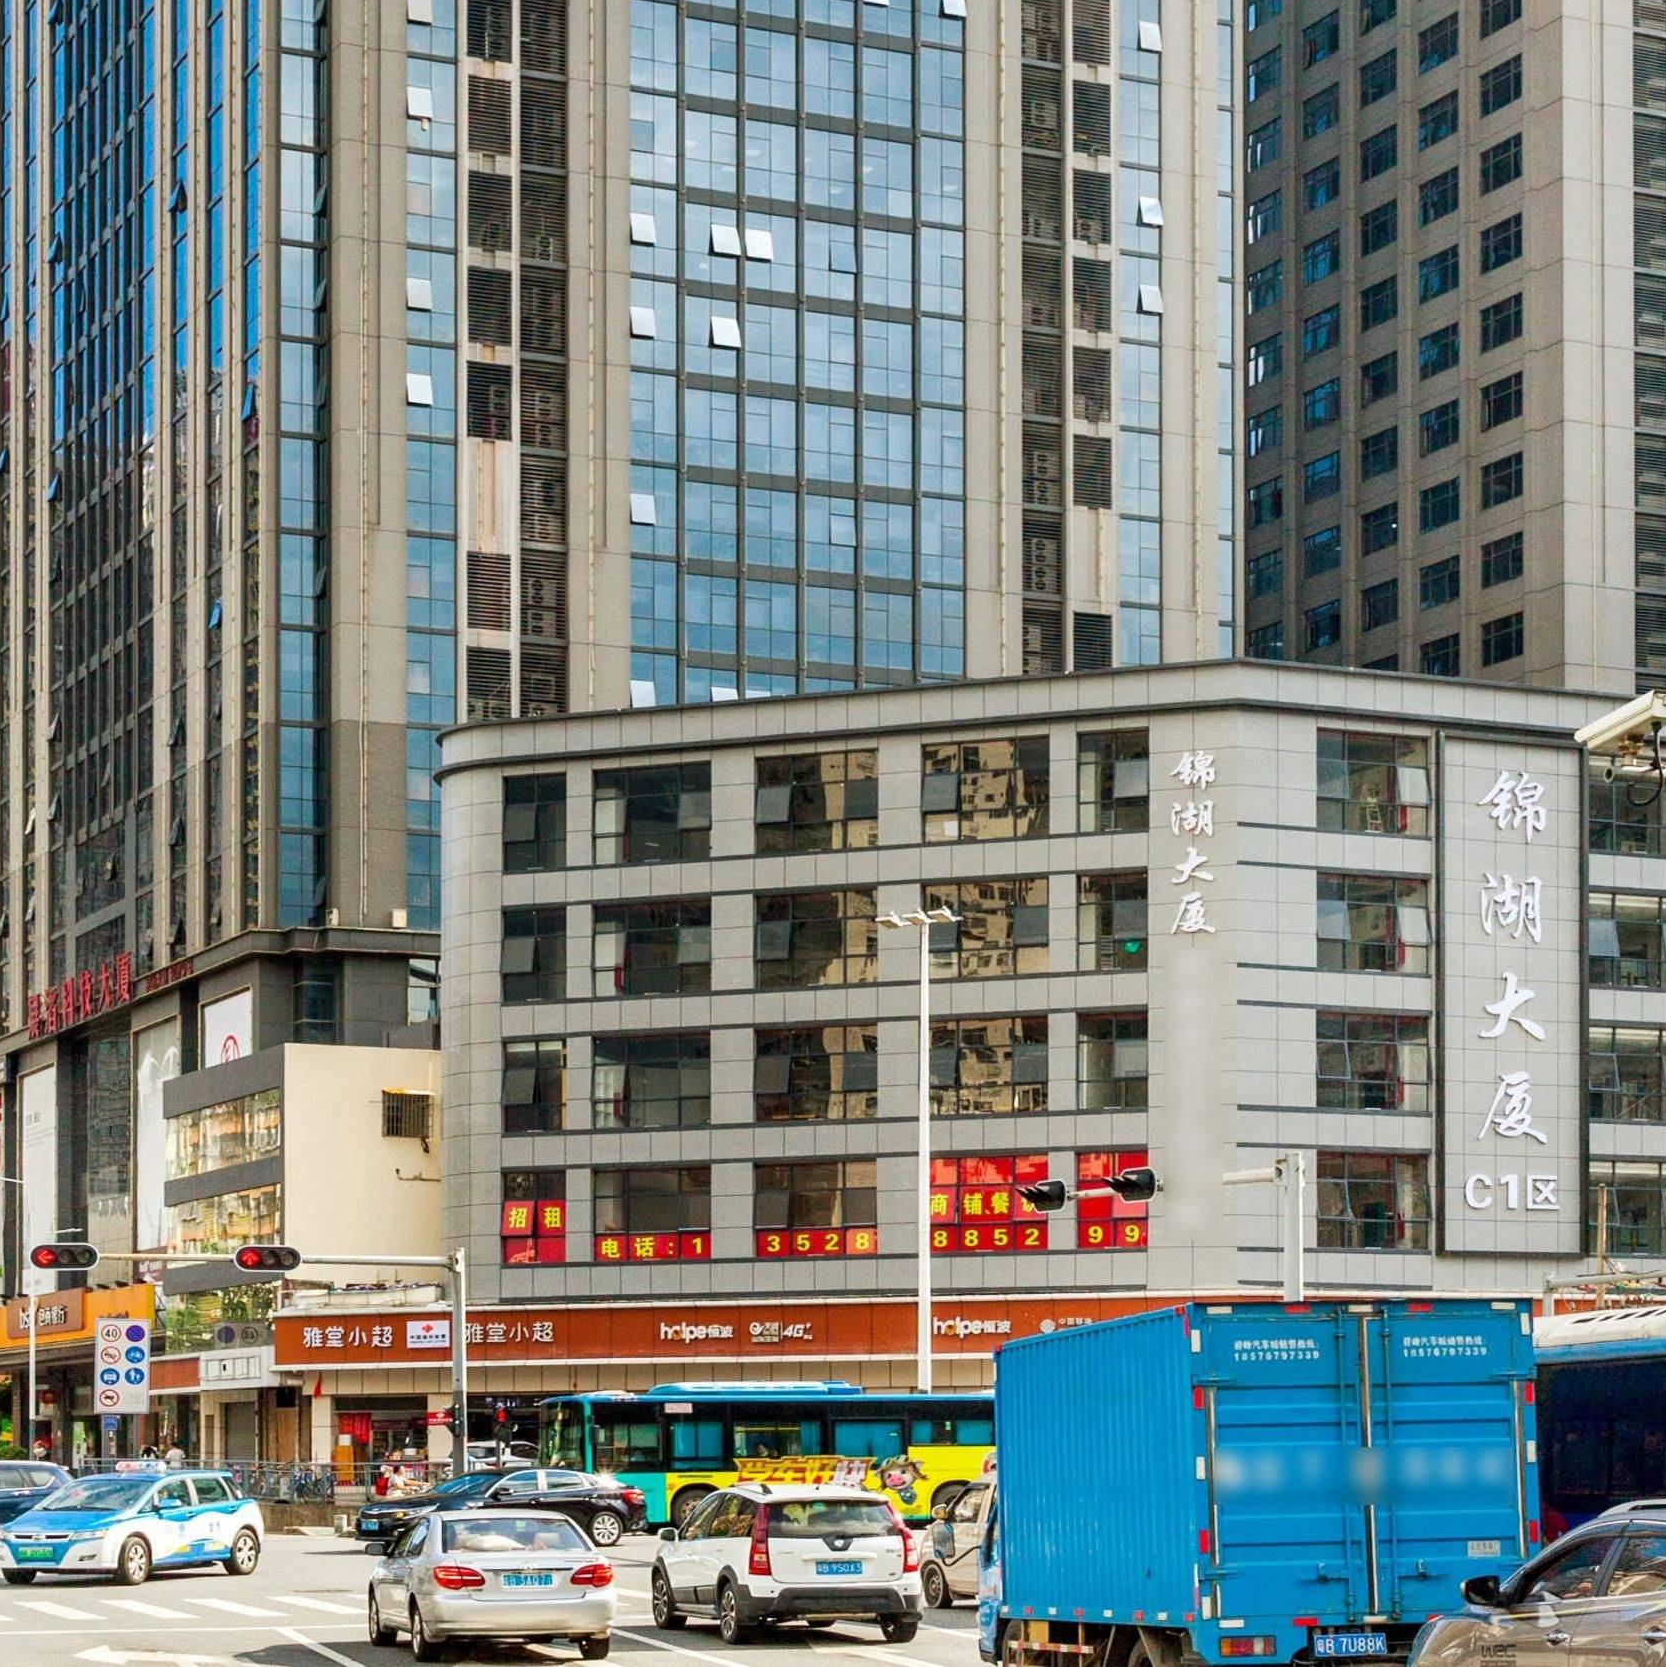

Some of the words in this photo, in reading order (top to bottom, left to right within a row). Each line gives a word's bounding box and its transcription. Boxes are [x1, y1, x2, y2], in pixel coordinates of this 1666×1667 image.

[1170, 750, 1217, 936] 锦湖大厦
[1478, 770, 1548, 1145] 锦湖大厦
[1464, 1174, 1560, 1210] C1区
[508, 1206, 562, 1229] 招租
[766, 1232, 870, 1253] 3528
[933, 1228, 1040, 1248] 8852
[1087, 1224, 1141, 1244] 99
[103, 1328, 118, 1338] 40
[302, 1325, 393, 1348] 雅堂小超
[465, 1321, 555, 1344] 雅堂小超
